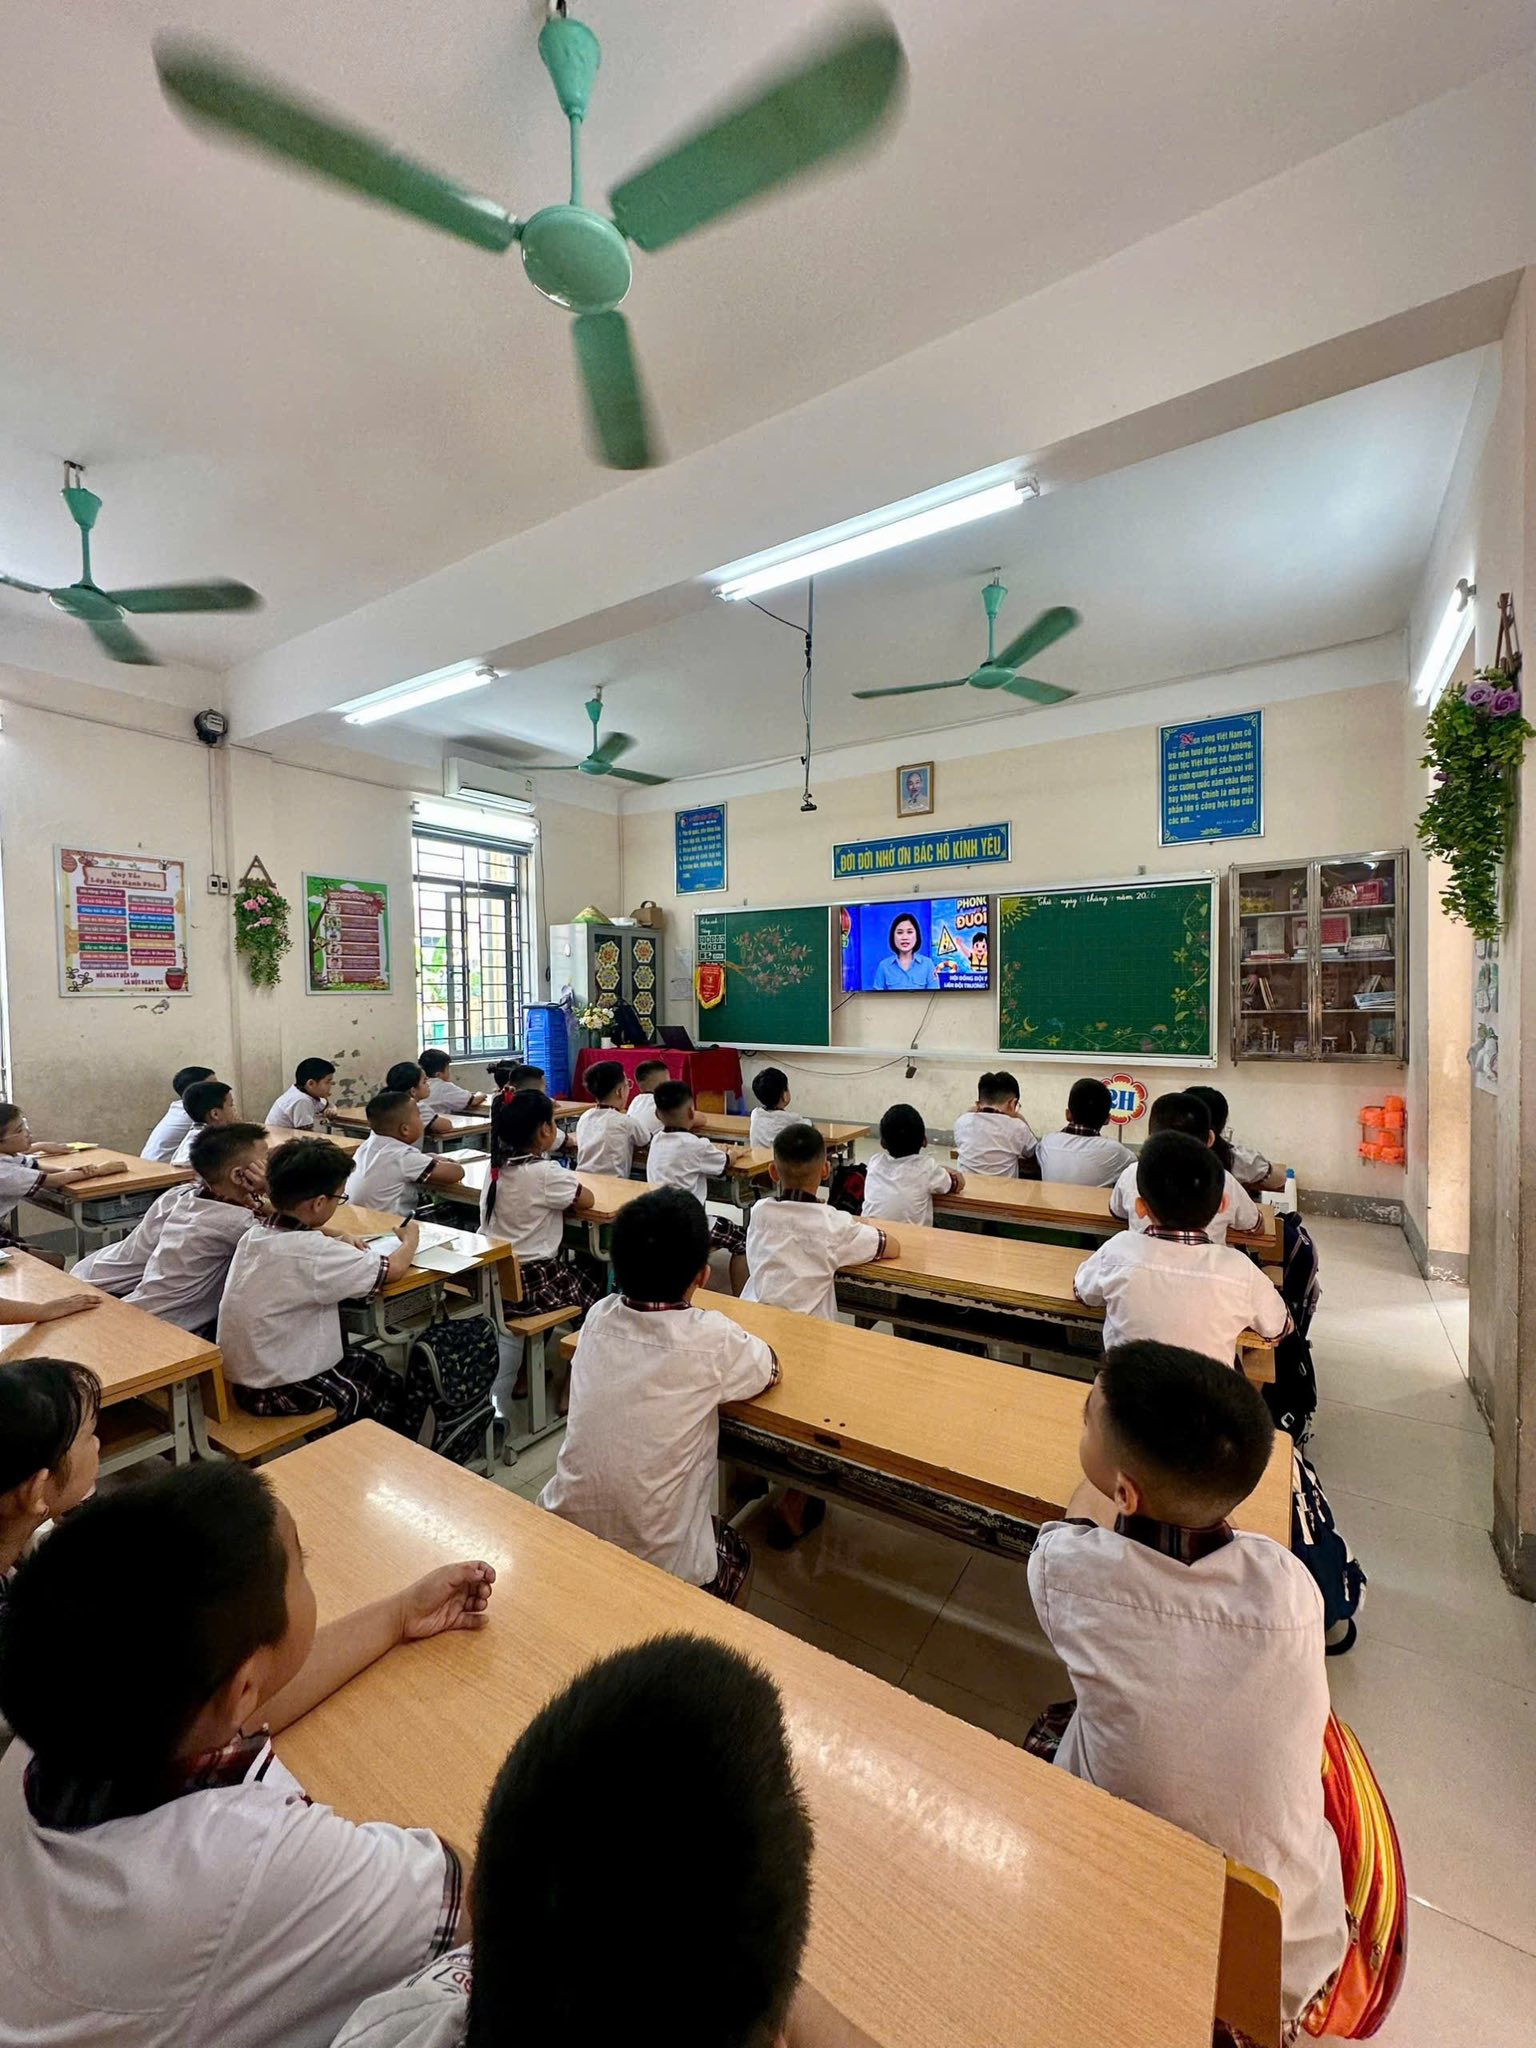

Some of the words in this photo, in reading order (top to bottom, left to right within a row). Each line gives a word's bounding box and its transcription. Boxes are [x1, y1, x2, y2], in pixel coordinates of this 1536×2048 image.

[1204, 757, 1218, 765] Nam
[858, 848, 873, 870] ĐỜI
[876, 844, 894, 868] NHỚ
[897, 846, 911, 865] ƠN
[914, 841, 933, 864] BÁC
[936, 836, 950, 861] HỒ
[953, 836, 978, 860] KÍNH
[980, 833, 1001, 856] YÊU
